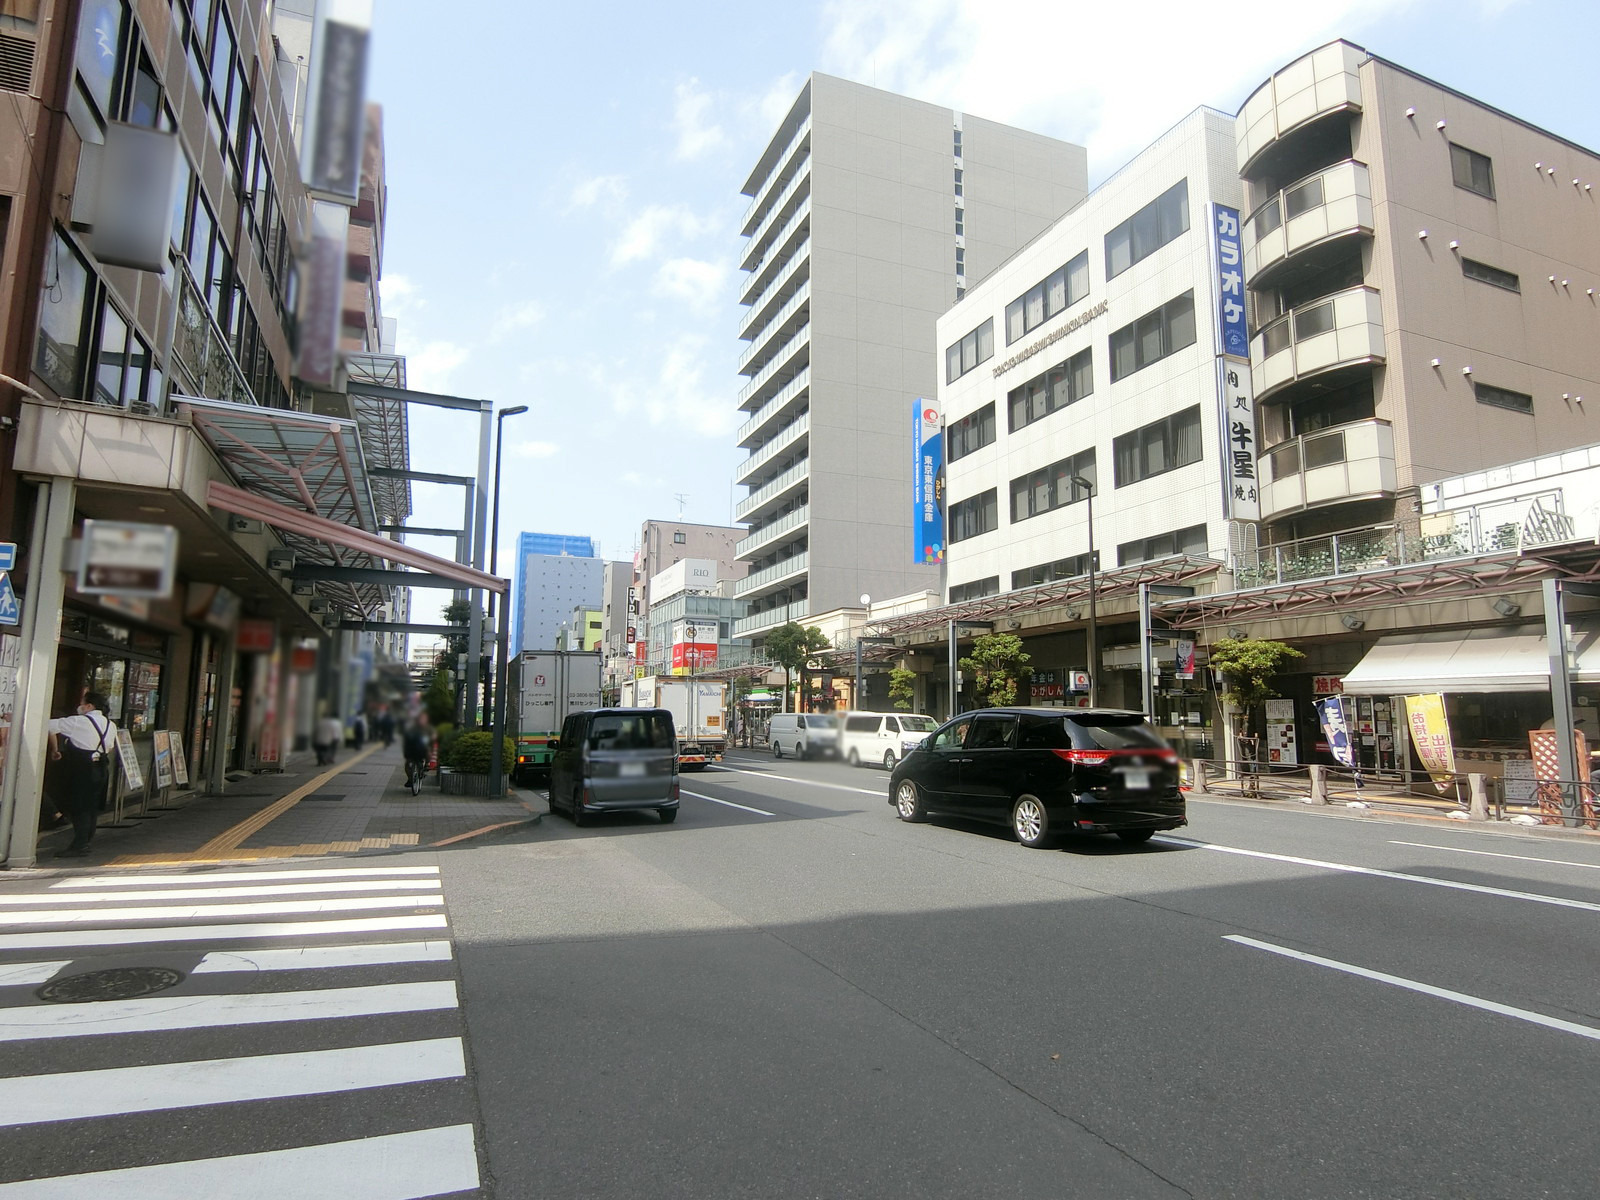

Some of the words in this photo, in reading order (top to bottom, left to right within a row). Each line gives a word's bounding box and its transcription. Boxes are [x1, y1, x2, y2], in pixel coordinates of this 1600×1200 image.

[1218, 211, 1243, 323] カラオケ
[992, 357, 1016, 379] TOKYO
[1081, 299, 1109, 325] BANK
[1232, 421, 1255, 480] 牛星
[924, 455, 933, 522] 東京東信用金庫
[1031, 672, 1054, 683] 年金は
[1315, 677, 1343, 692] 焼肉
